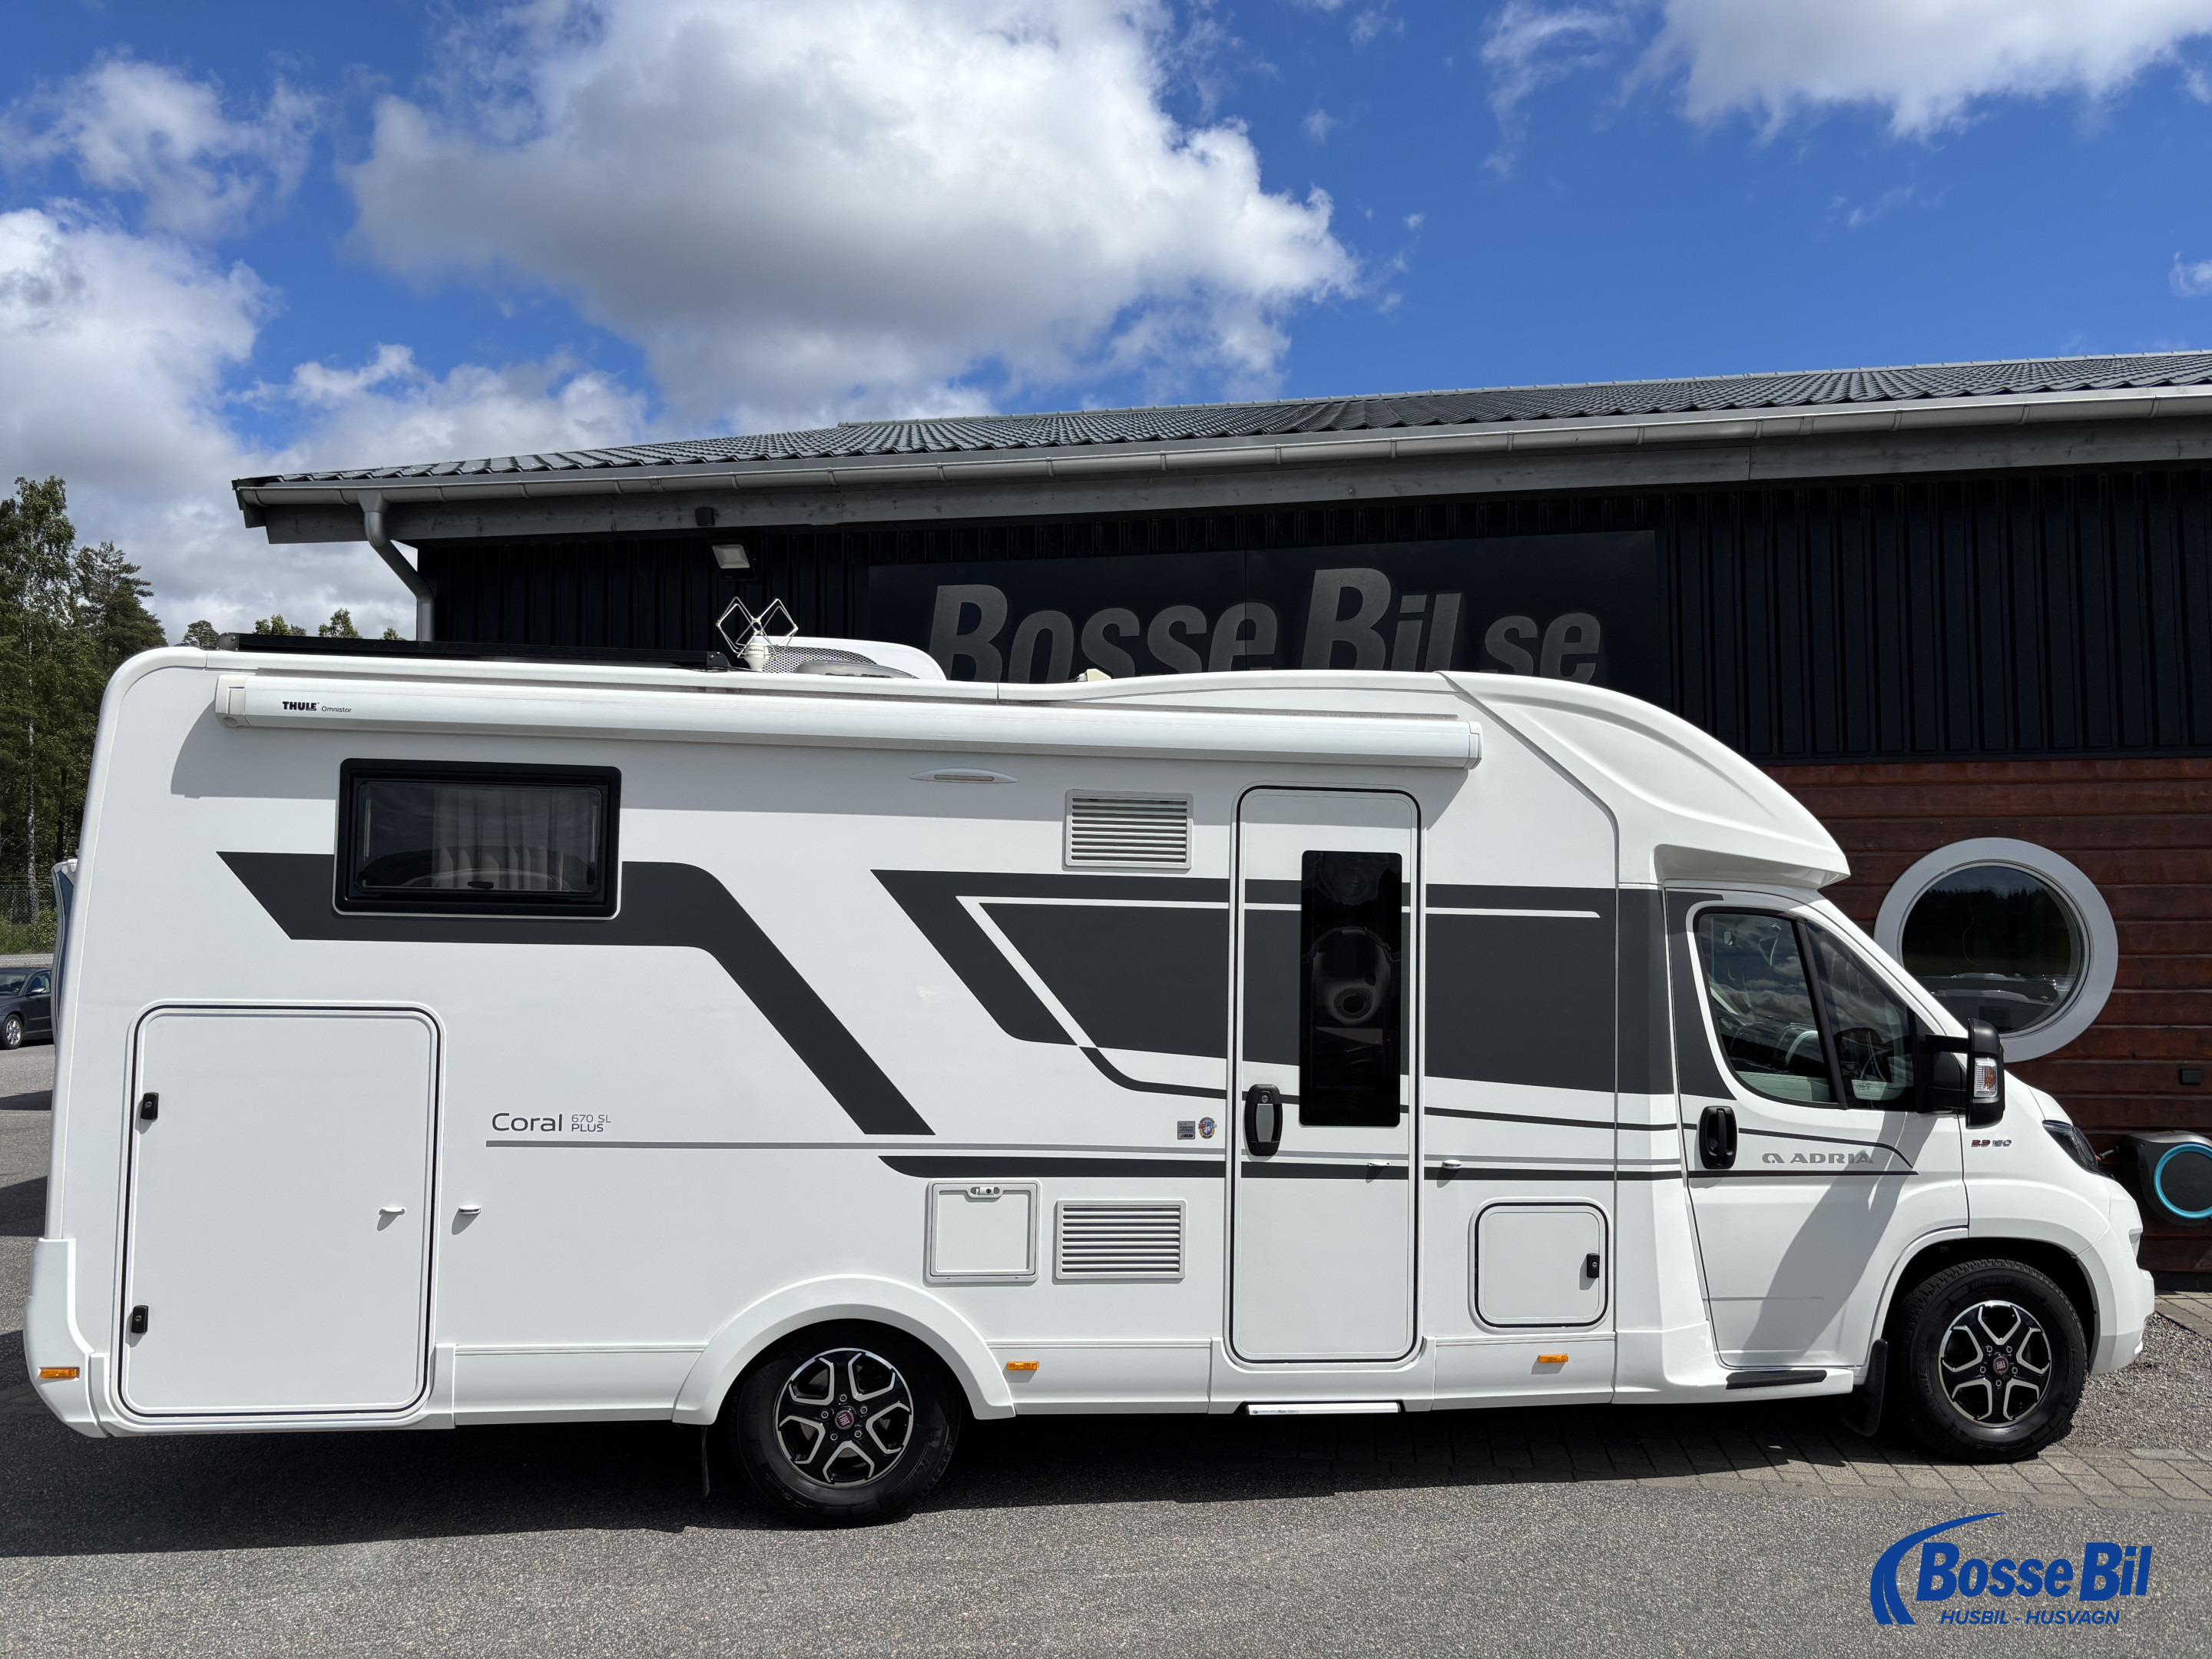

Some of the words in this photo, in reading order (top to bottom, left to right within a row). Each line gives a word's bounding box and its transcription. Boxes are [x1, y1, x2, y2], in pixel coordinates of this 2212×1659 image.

[928, 584, 1277, 684] Bosse
[282, 700, 317, 711] THULE
[492, 1112, 563, 1132] Coral
[571, 1114, 594, 1123] 670
[598, 1114, 611, 1123] SL
[571, 1124, 604, 1132] PLUS
[1790, 1152, 1875, 1164] ADRIA
[839, 1414, 849, 1426] FIAT
